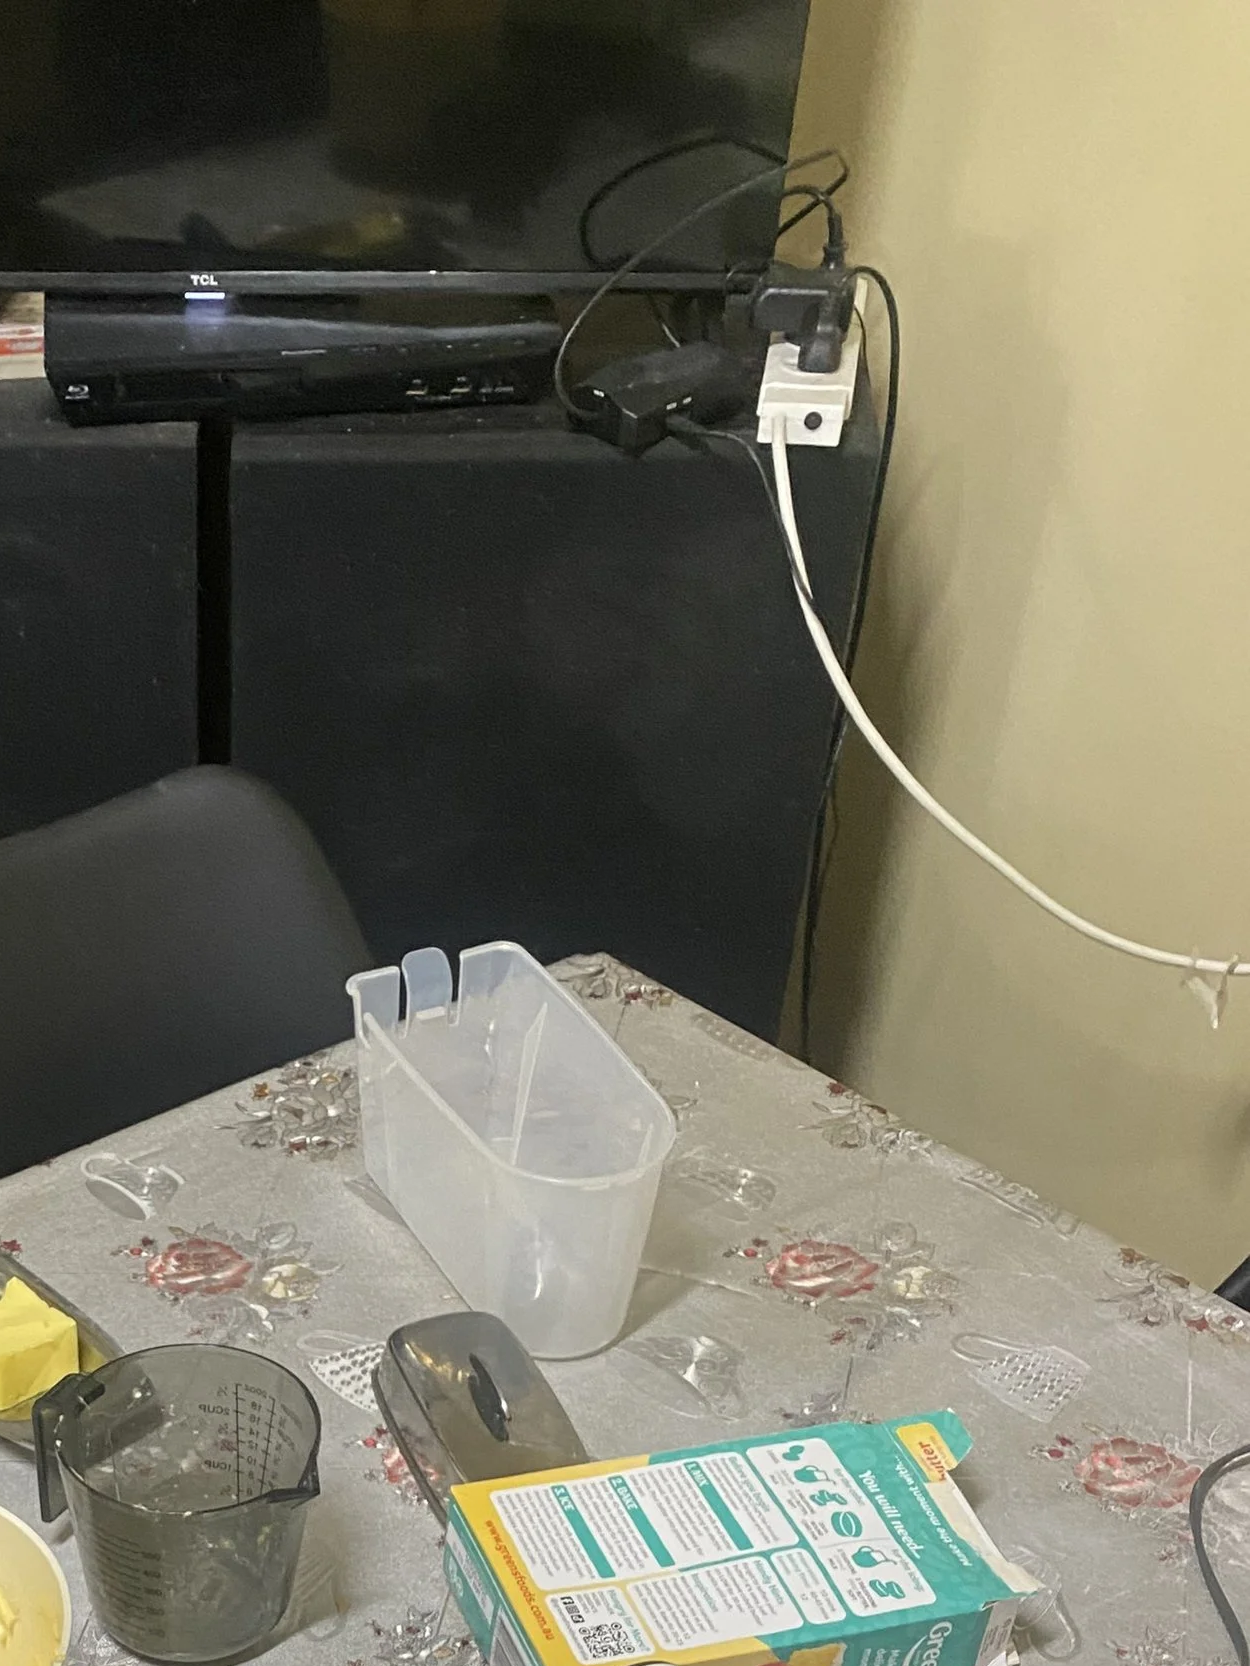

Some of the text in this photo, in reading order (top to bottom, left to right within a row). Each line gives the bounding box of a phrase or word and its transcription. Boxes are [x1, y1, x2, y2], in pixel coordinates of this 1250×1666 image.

[190, 274, 218, 286] TCL
[691, 1470, 709, 1487] MIX
[728, 1456, 770, 1513] Before you begin
[559, 1496, 575, 1511] ICE
[617, 1486, 638, 1510] BAKE
[859, 1470, 880, 1493] You
[875, 1495, 901, 1518] will
[909, 1486, 941, 1526] moment
[936, 1527, 953, 1544] the
[950, 1544, 973, 1566] Make
[485, 1520, 554, 1641] www.greensfoods.com.au
[691, 1573, 719, 1613] Inspiration
[753, 1560, 784, 1605] Handy Hints
[607, 1589, 627, 1617] Hungry
